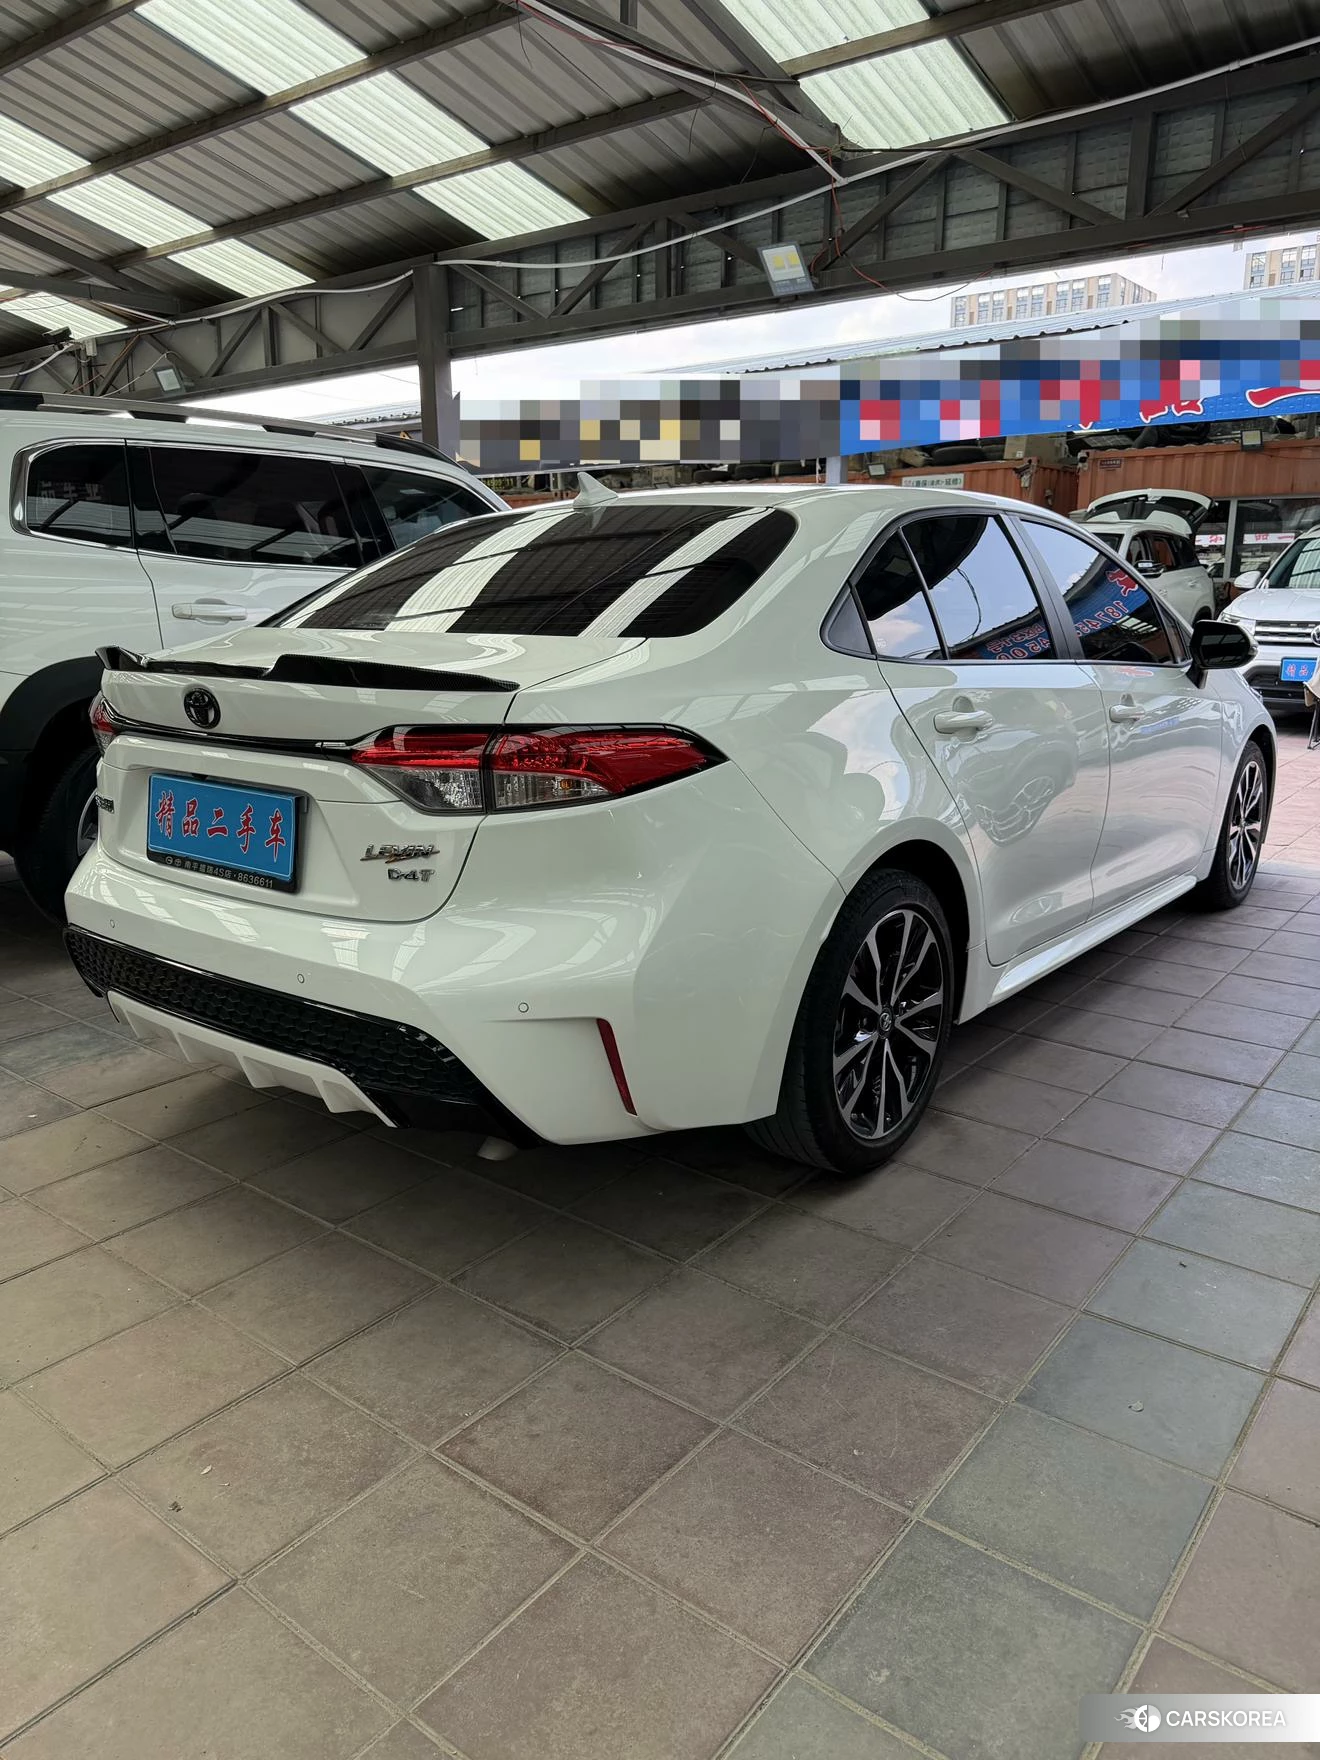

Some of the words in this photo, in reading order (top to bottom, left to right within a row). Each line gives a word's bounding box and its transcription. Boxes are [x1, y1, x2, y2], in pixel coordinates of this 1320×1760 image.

[155, 789, 286, 863] 精品二手车
